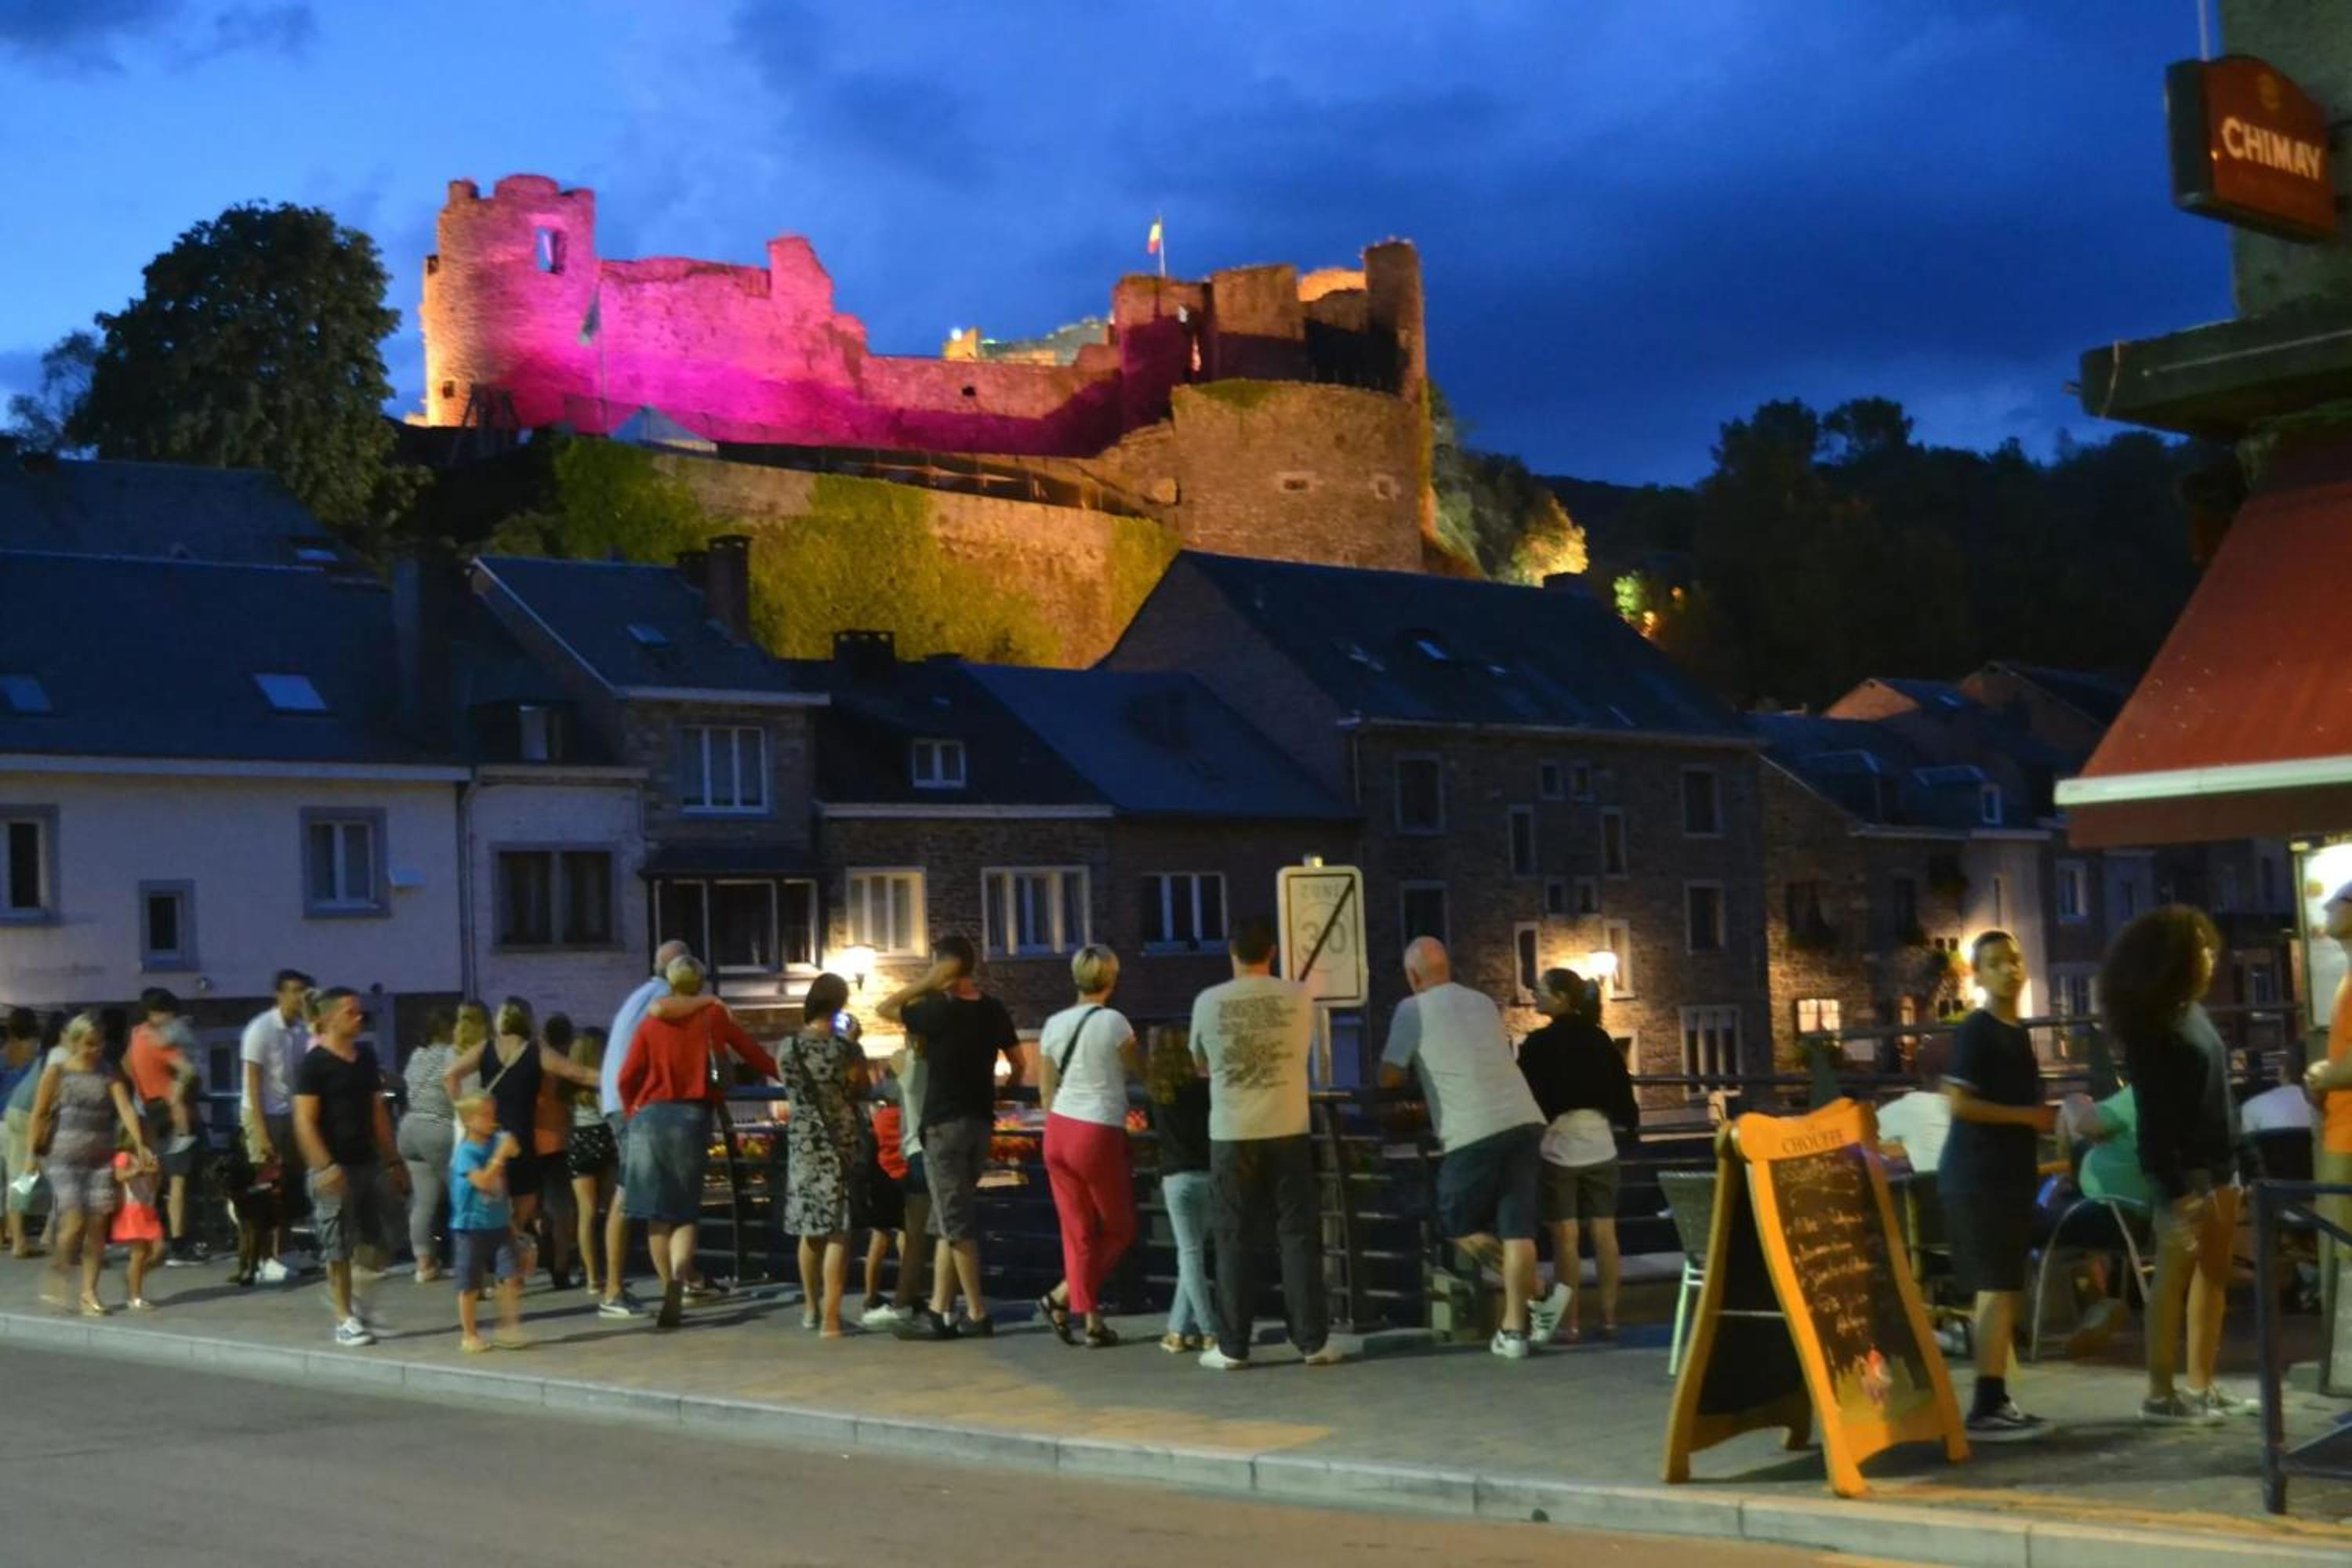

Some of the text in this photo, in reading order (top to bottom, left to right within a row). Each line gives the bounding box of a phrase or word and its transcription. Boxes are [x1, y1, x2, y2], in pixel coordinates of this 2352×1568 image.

[2222, 115, 2321, 181] CHIMAY
[1301, 882, 1343, 898] ZONE
[1300, 921, 1348, 955] 30
